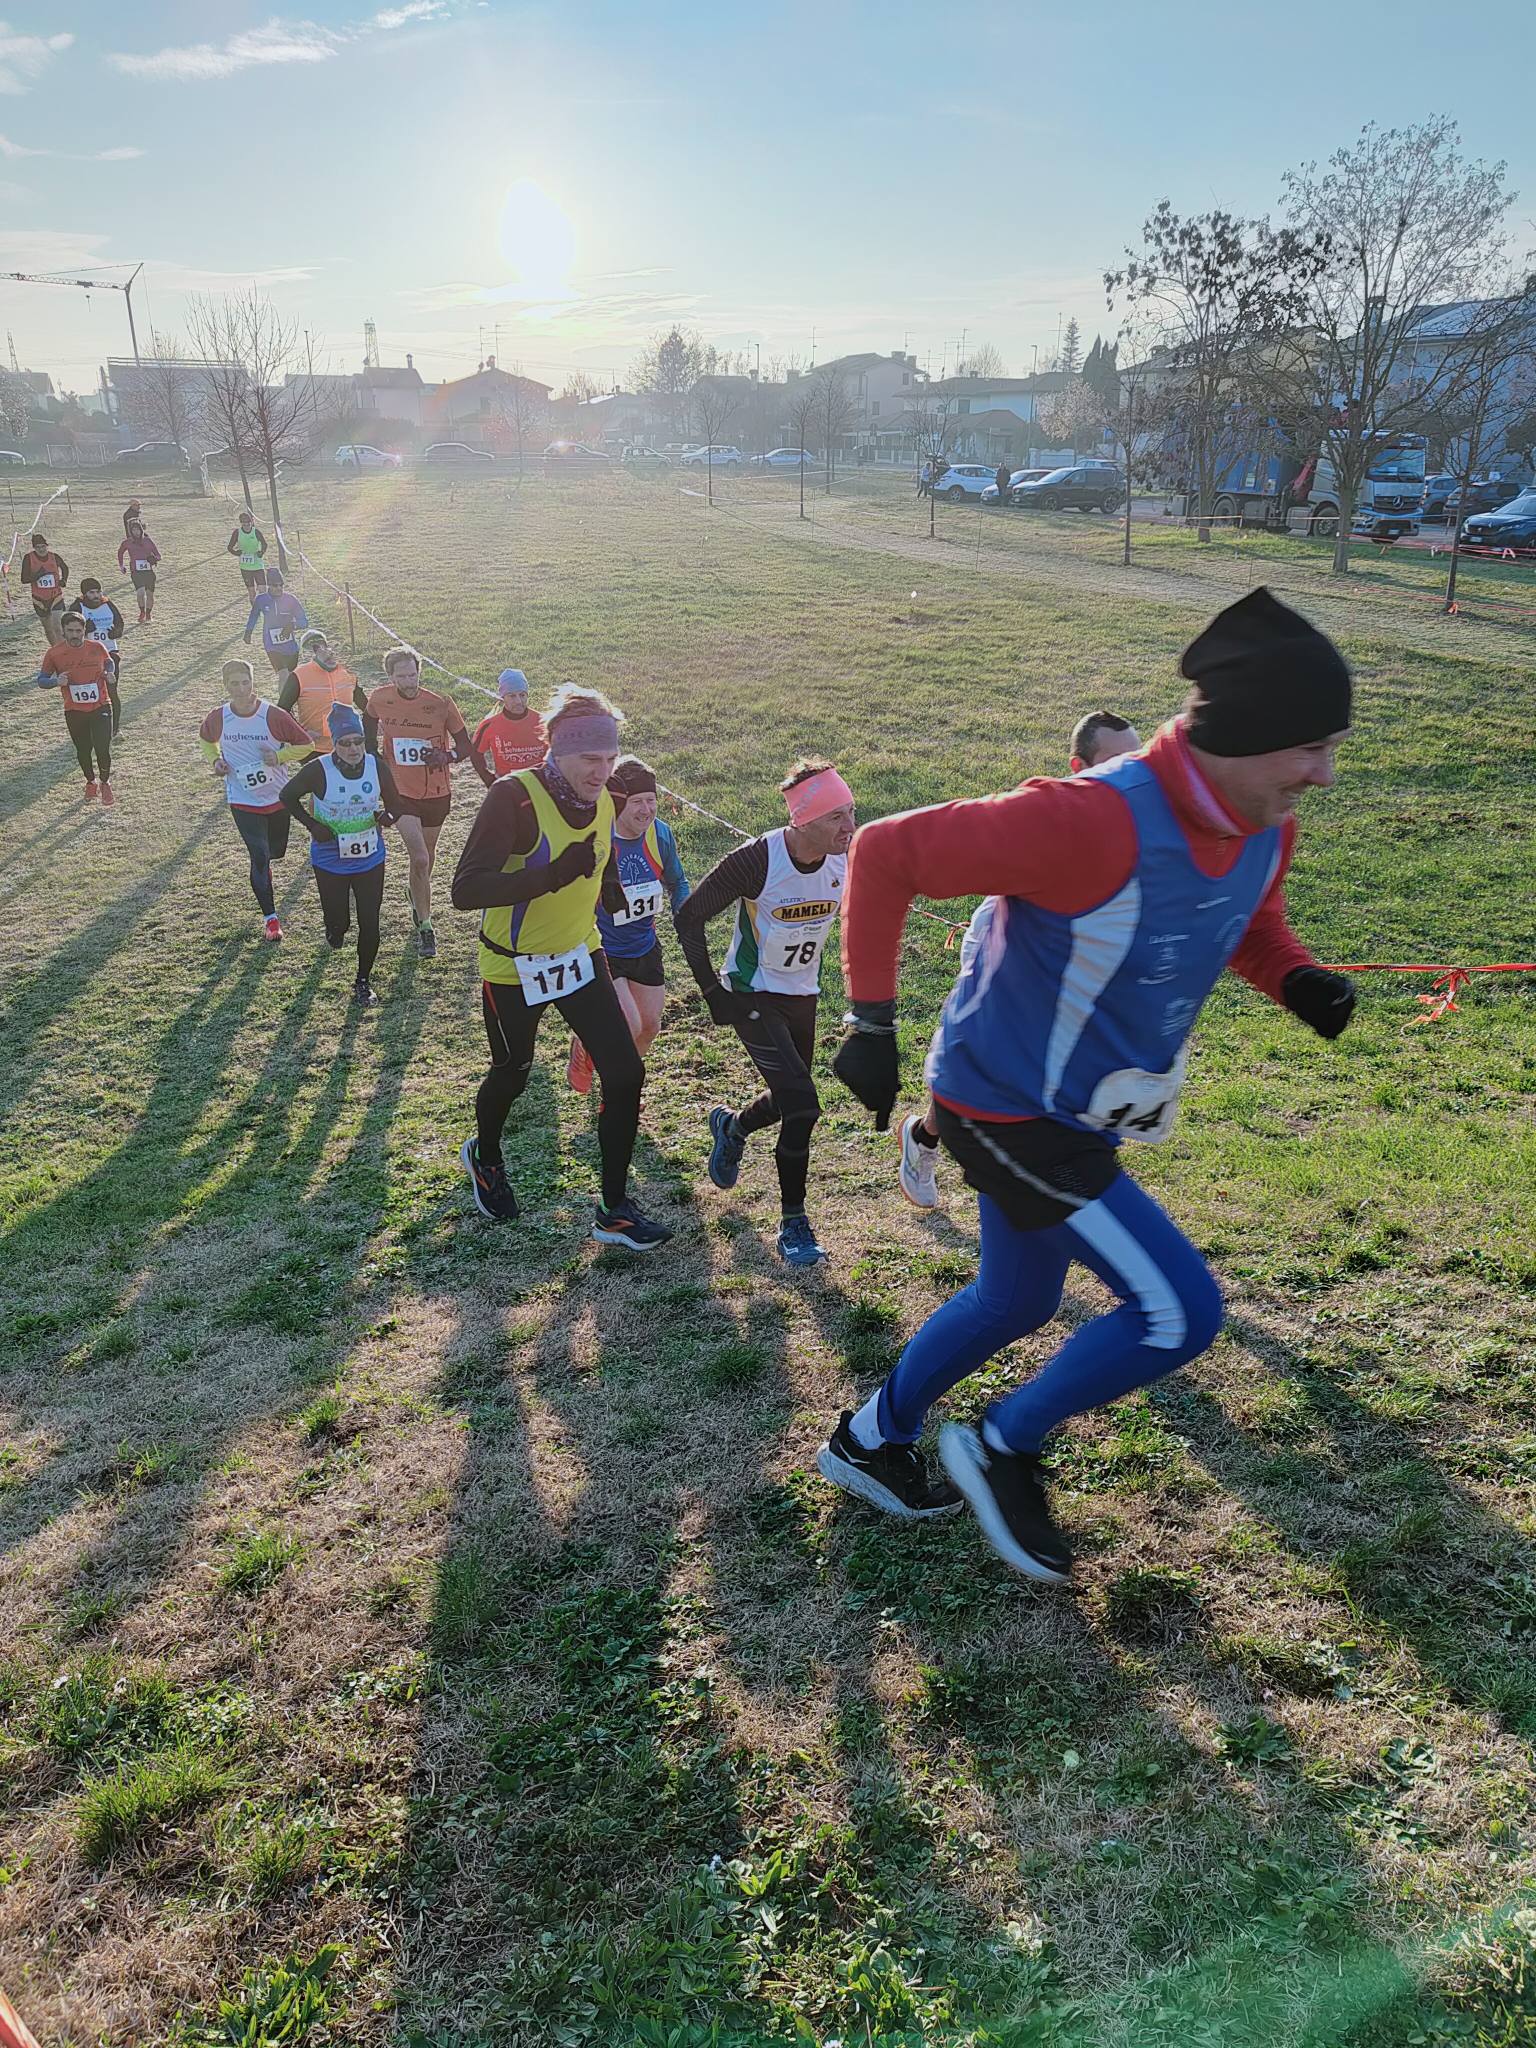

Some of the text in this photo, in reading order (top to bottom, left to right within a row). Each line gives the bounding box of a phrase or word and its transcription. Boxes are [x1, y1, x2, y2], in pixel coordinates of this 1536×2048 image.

[39, 579, 52, 587] 191
[94, 632, 106, 640] 50
[75, 690, 97, 701] 194
[246, 771, 267, 786] 56
[351, 841, 369, 855] 81
[625, 895, 655, 919] 131
[781, 902, 832, 919] MAMELI
[783, 941, 817, 967] 78
[533, 958, 582, 994] 171
